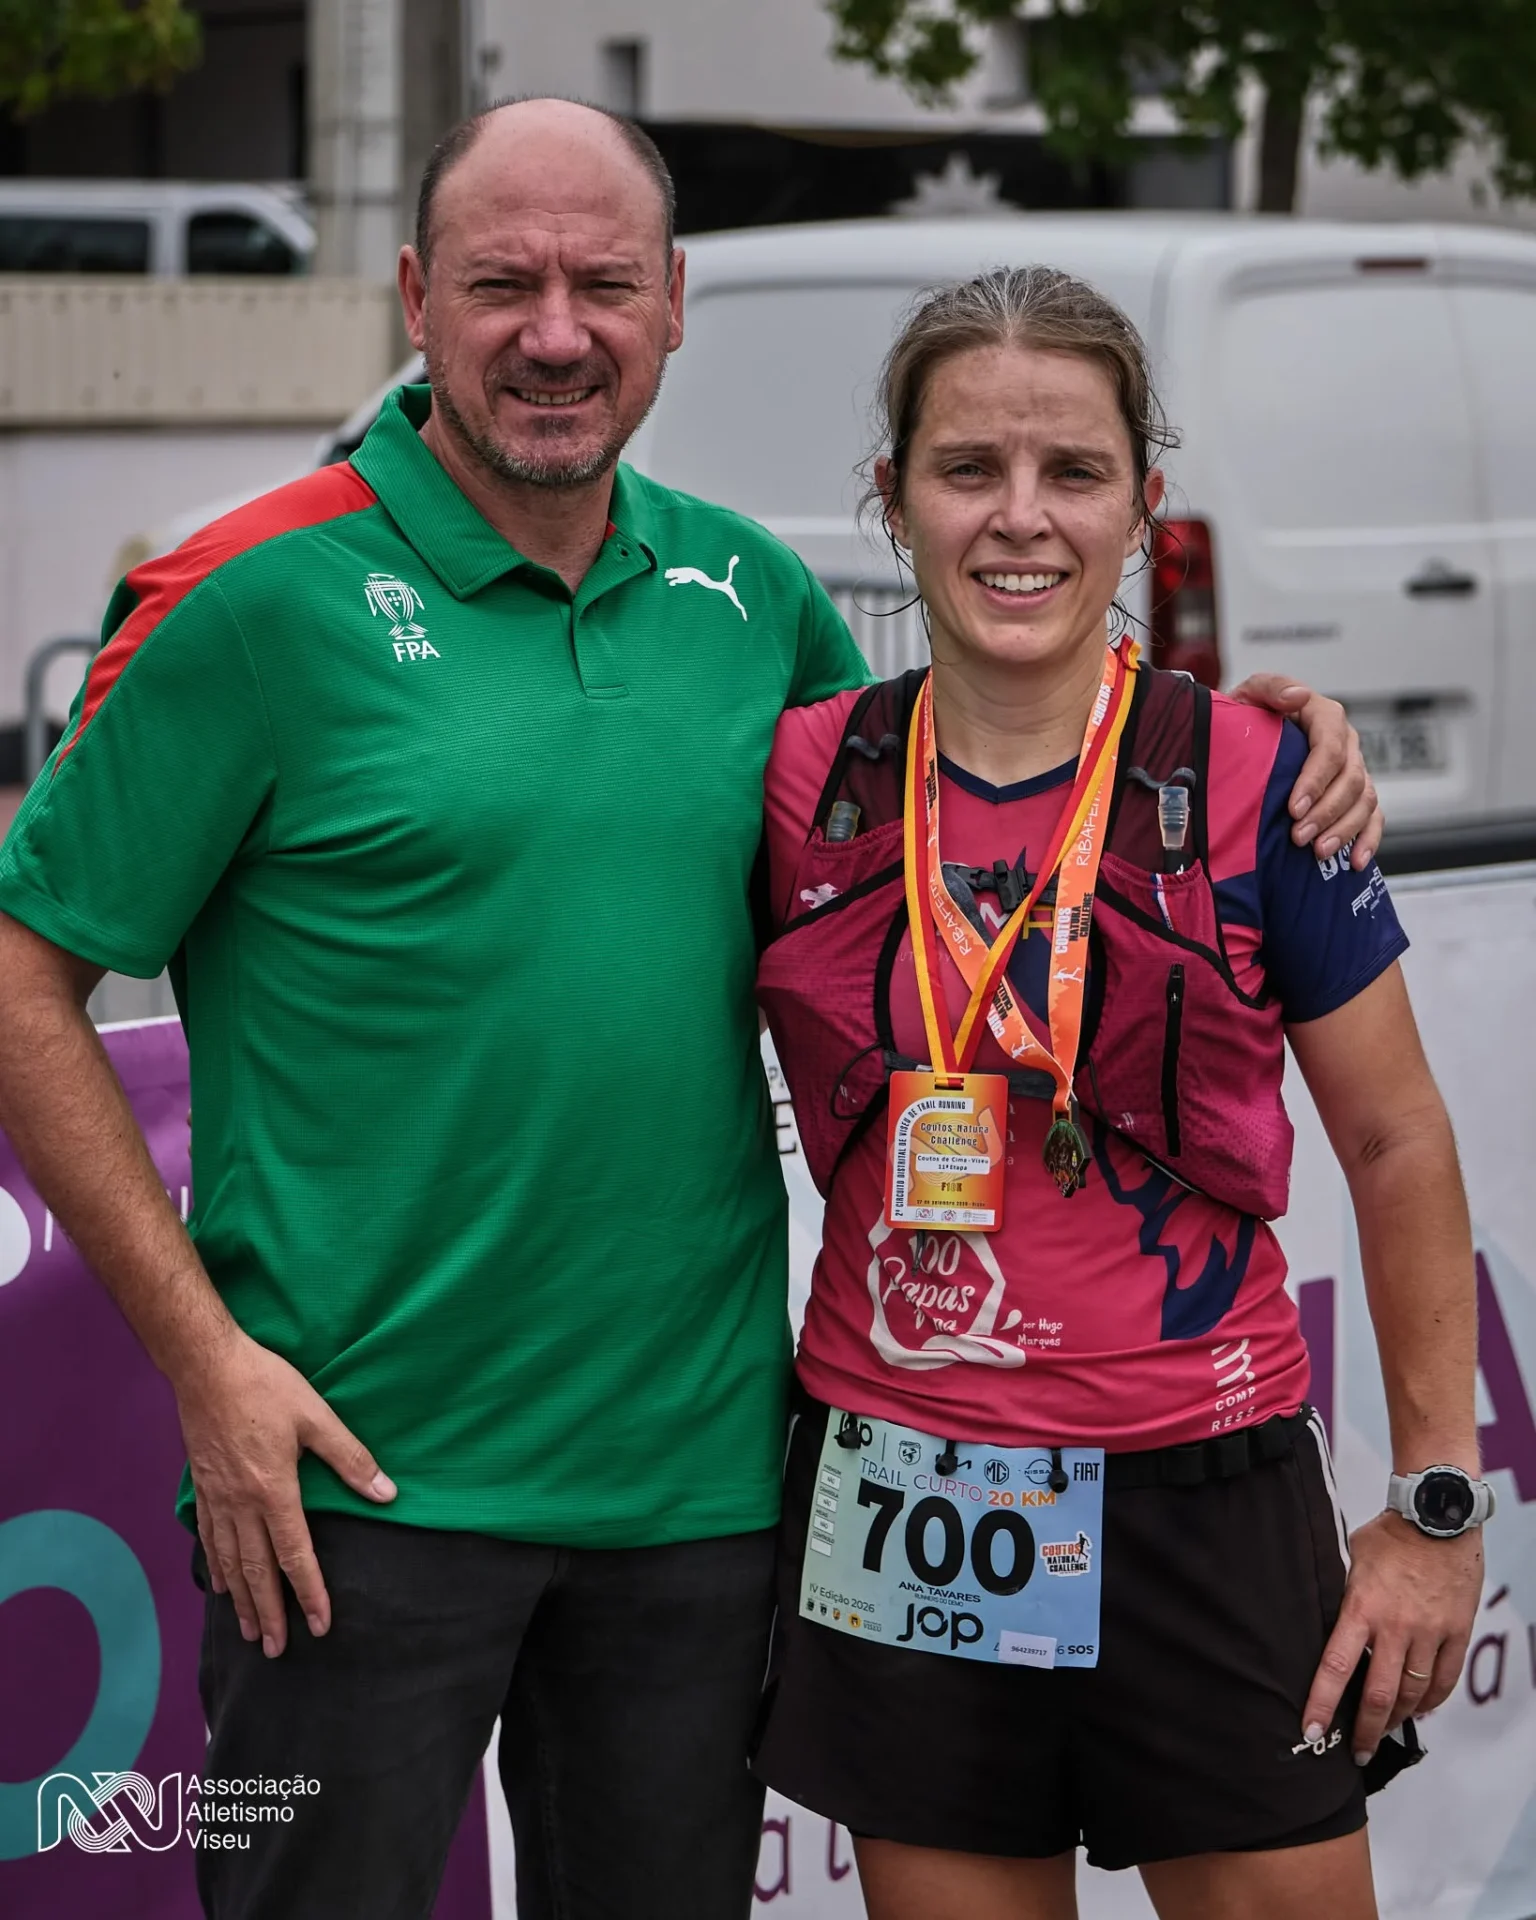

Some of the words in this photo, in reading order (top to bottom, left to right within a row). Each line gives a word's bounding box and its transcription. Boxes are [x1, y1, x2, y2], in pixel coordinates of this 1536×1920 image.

[392, 640, 441, 662] FPA
[1091, 683, 1111, 727] COUTOS
[1068, 905, 1082, 942] NATURA
[1079, 892, 1094, 938] CHALLENGE
[1055, 907, 1072, 955] COUTOS
[907, 1108, 917, 1118] DE
[917, 1100, 936, 1111] TRAIL
[938, 1100, 966, 1109] RUNNING
[899, 1117, 911, 1136] VISEU
[920, 1122, 953, 1133] Coutos
[957, 1123, 989, 1134] Natura
[930, 1135, 977, 1147] Challenge
[897, 1148, 906, 1179] DISTRITAL
[896, 1180, 904, 1207] CIRCUITO
[1022, 1322, 1036, 1330] por
[1038, 1318, 1063, 1335] Hugo
[1017, 1334, 1061, 1350] Marques
[1215, 1386, 1256, 1412] COMP
[1211, 1405, 1255, 1432] RESS
[861, 1456, 907, 1487] TRAIL
[913, 1474, 982, 1501] CURTO
[987, 1490, 1015, 1507] 20
[1021, 1490, 1057, 1507] KM
[985, 1461, 1008, 1483] MG
[1073, 1462, 1100, 1481] FIAT
[856, 1477, 1036, 1597] 700
[1042, 1543, 1081, 1557] COUTOS
[1047, 1555, 1076, 1565] NATURA
[1049, 1563, 1088, 1573] CHALLENGE
[809, 1583, 819, 1593] IV
[820, 1587, 850, 1605] Edição
[851, 1598, 875, 1613] 2026
[898, 1581, 924, 1593] ANA
[926, 1586, 981, 1603] TAVARES
[896, 1603, 984, 1650] jop
[1067, 1645, 1094, 1655] SOS
